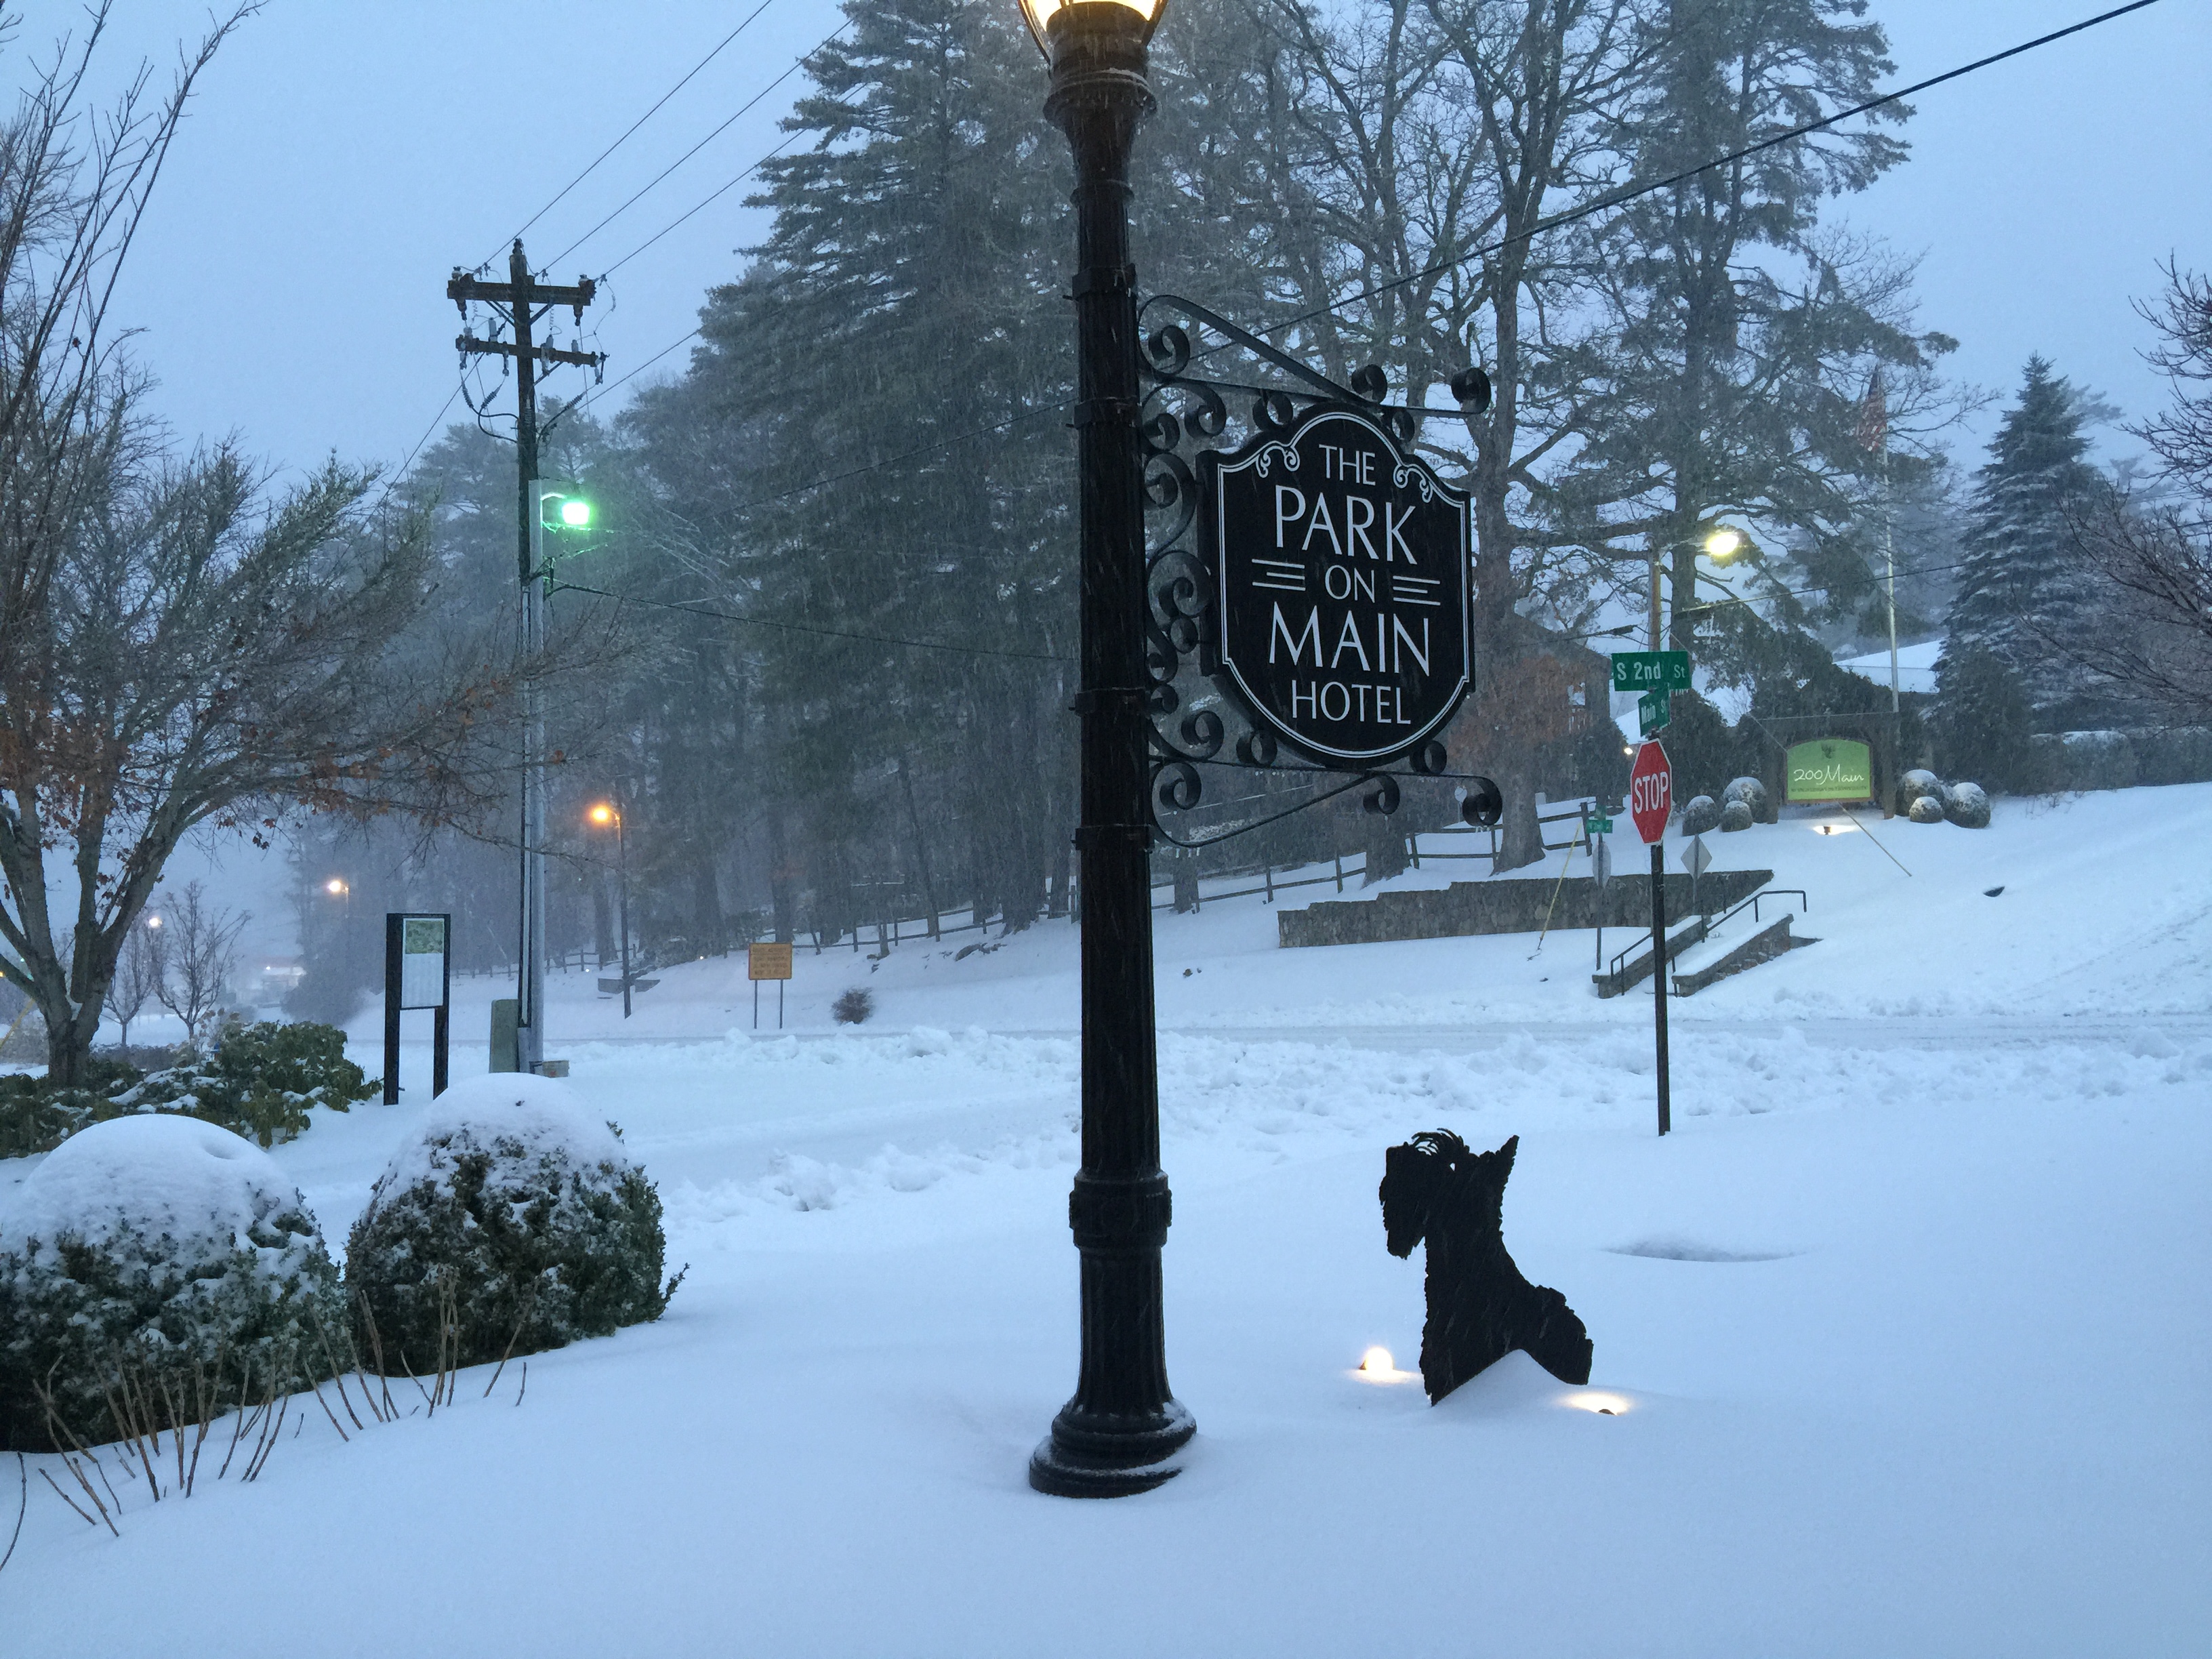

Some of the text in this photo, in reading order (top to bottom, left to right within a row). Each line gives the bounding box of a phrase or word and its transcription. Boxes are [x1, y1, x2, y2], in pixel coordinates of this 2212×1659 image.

[1319, 443, 1376, 487] THE
[1275, 484, 1418, 565] PARK
[1324, 565, 1376, 604] ON
[1268, 600, 1430, 677] MAIN
[1616, 661, 1686, 681] S 2nd St
[1291, 679, 1412, 725] HOTEL
[1633, 771, 1669, 814] STOP
